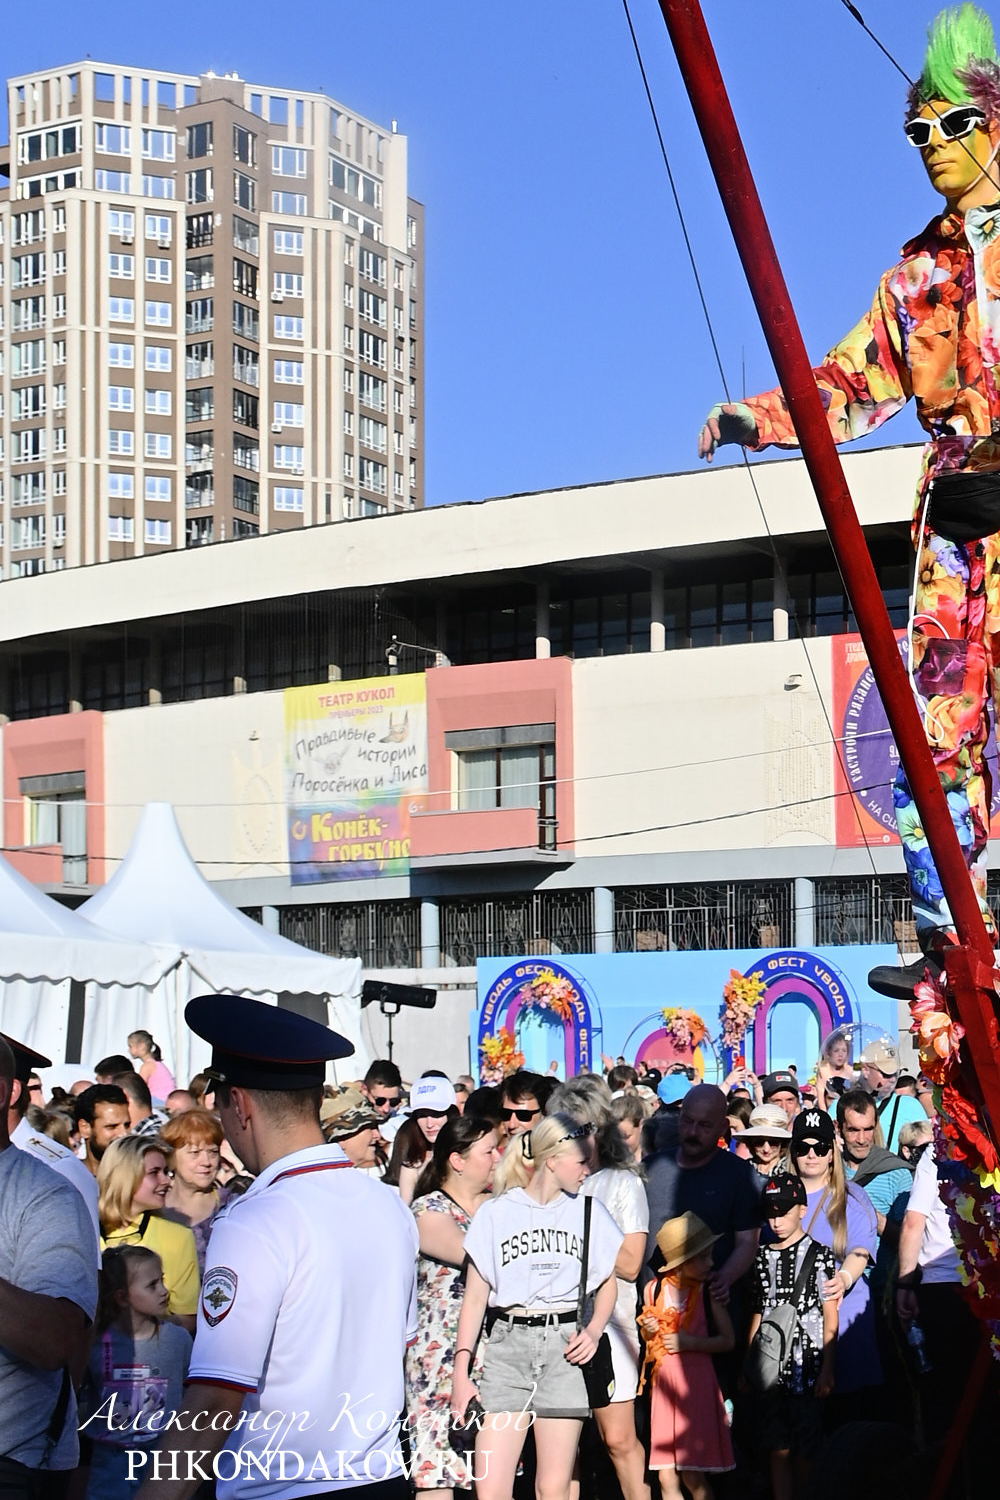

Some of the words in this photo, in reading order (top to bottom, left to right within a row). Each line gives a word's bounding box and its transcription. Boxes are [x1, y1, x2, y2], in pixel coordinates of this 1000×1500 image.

[318, 693, 354, 708] ТЕАТР
[356, 687, 395, 703] КУКОЛ
[848, 668, 876, 717] РЯЗАНС
[295, 728, 376, 761] Правдивые
[358, 745, 416, 765] истории
[292, 771, 369, 796] Поросёнка
[374, 777, 384, 788] и
[388, 763, 427, 784] Лиса
[328, 838, 410, 871] ГОРБУНО
[767, 957, 808, 970] ФЕСТ
[814, 965, 847, 1018] УВОДЬ
[482, 976, 513, 1025] УВОДЬ
[579, 1028, 589, 1067] ФЕС
[805, 1112, 820, 1128] NY
